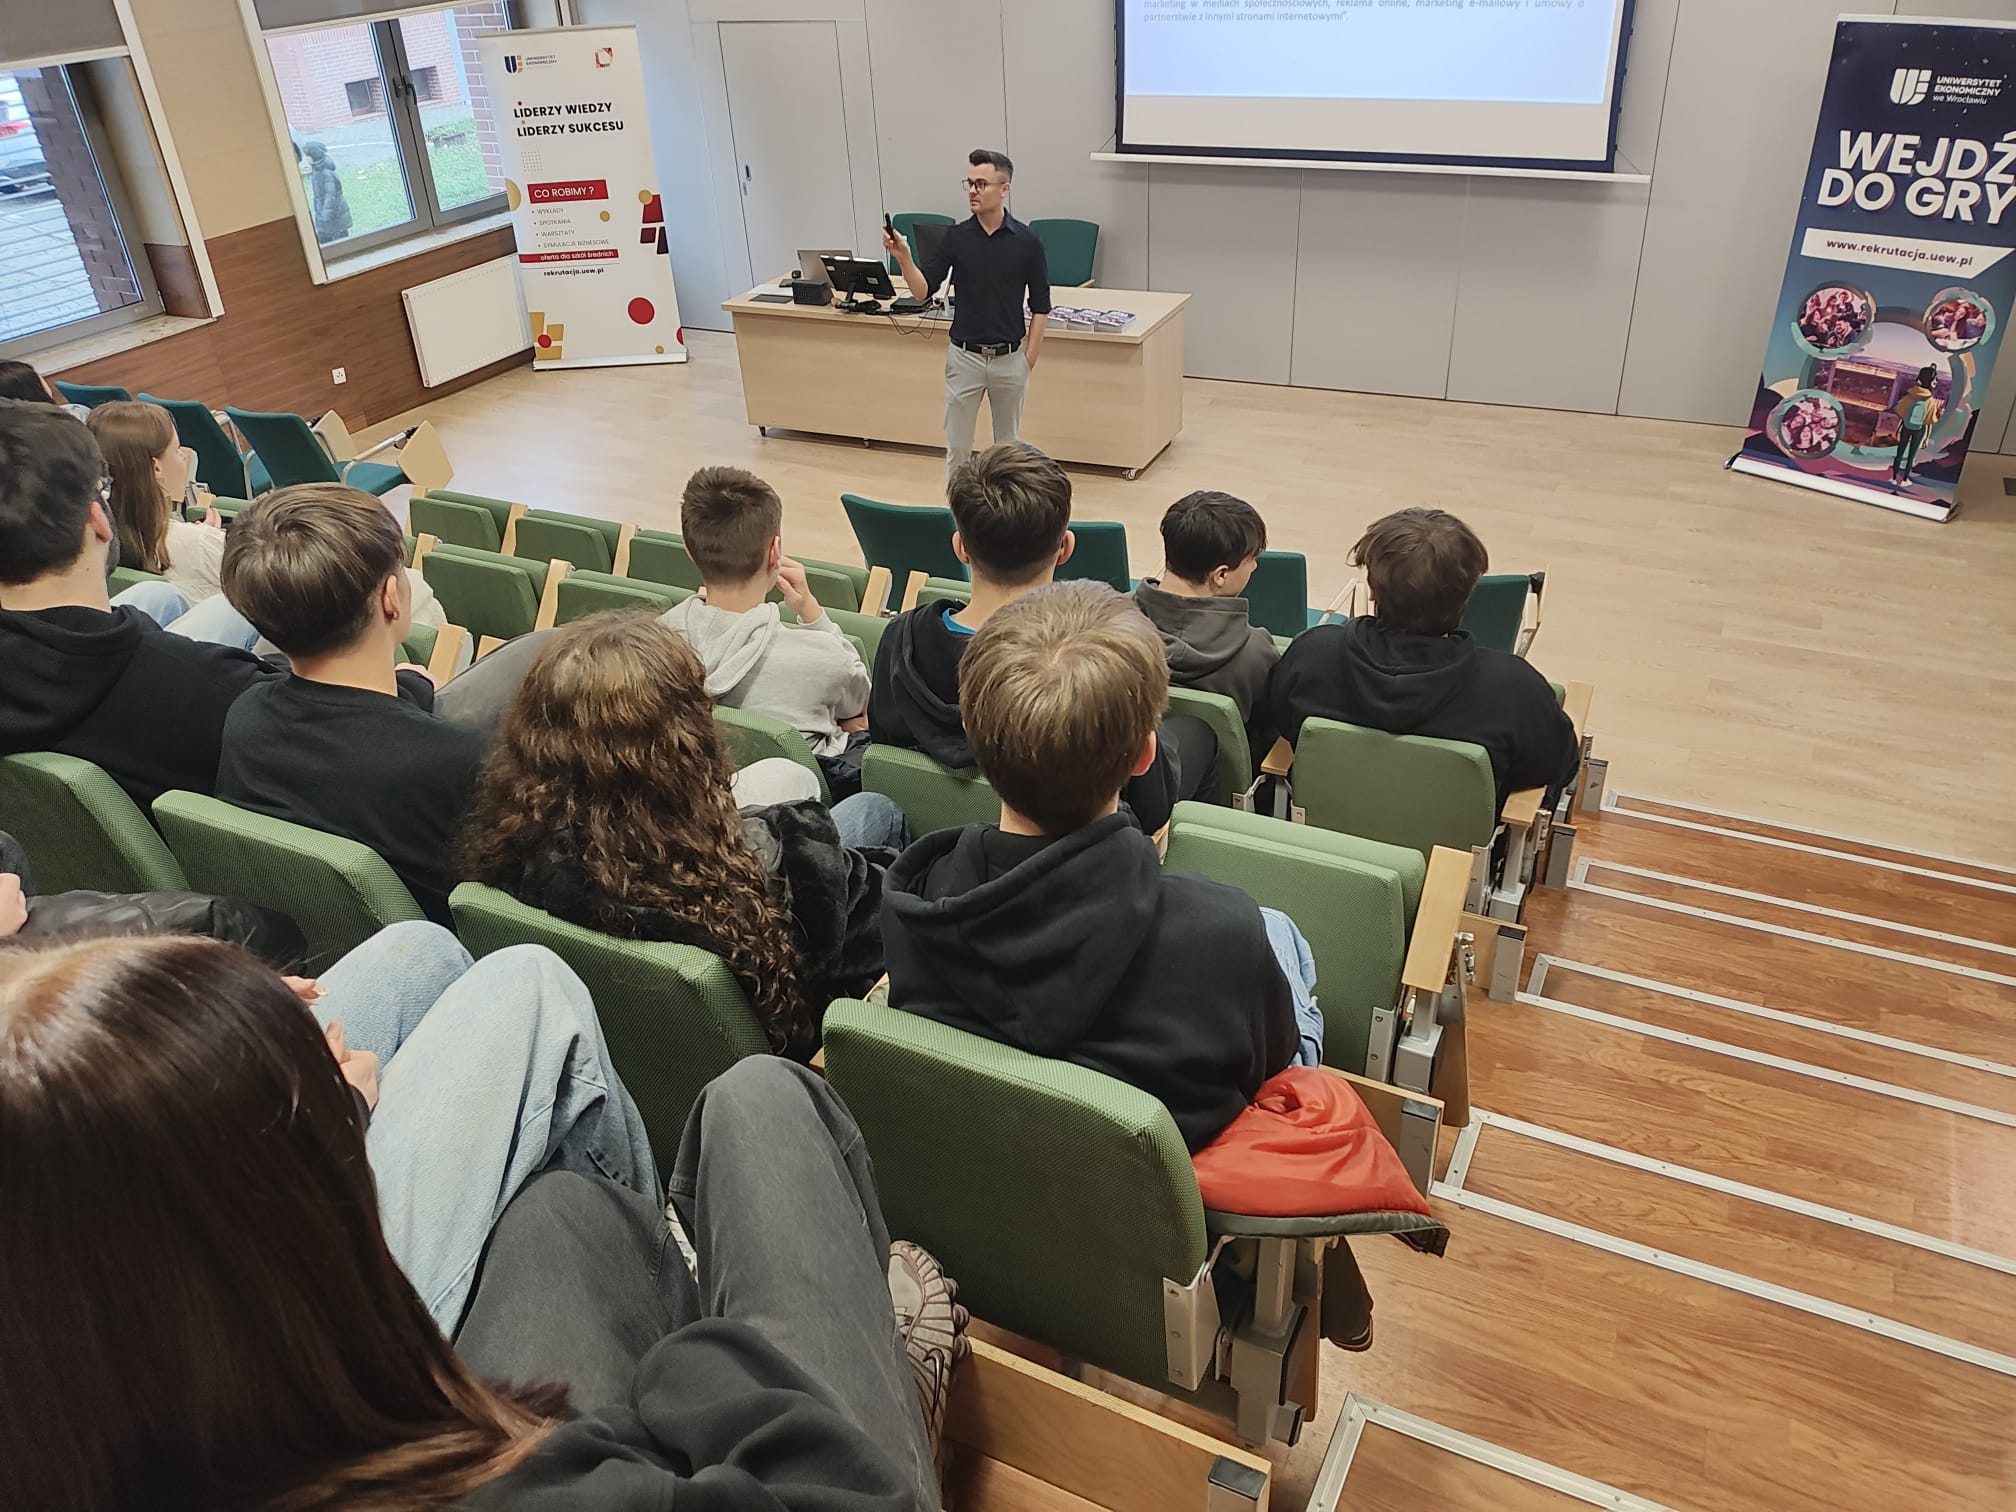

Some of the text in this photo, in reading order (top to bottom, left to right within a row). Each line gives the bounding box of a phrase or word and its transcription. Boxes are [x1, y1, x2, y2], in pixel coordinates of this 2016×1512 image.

[1144, 0, 1186, 9] marketing
[1378, 0, 1410, 8] online,
[1416, 0, 1463, 8] marketing
[1469, 0, 1520, 8] e-mailowy
[1535, 0, 1573, 8] umowy
[1144, 11, 1196, 22] partnerstwie
[1205, 12, 1234, 22] innymi
[1236, 12, 1274, 21] stronami
[1936, 76, 2002, 87] UNIWERSYTET
[1934, 85, 2001, 96] EKONOMICZNY
[1946, 94, 1988, 105] Wrocławiu
[513, 102, 612, 119] LIDERZY WIEDZY
[517, 120, 624, 137] LIDERZY SUKCESU
[1838, 129, 2016, 185] WEJDŹ
[534, 189, 550, 198] CO
[551, 187, 587, 198] ROBIMY
[1817, 167, 2016, 226] DO GRY
[539, 218, 571, 226] SPOTKANIA
[541, 229, 575, 237] WARSZTATY
[543, 240, 576, 248] SYMULACJE
[571, 251, 587, 259] szkół
[588, 250, 614, 258] średnich
[1827, 238, 1974, 268] www.rekrutacja.uew.pl
[543, 266, 604, 276] rekrutacja.uew.pl
